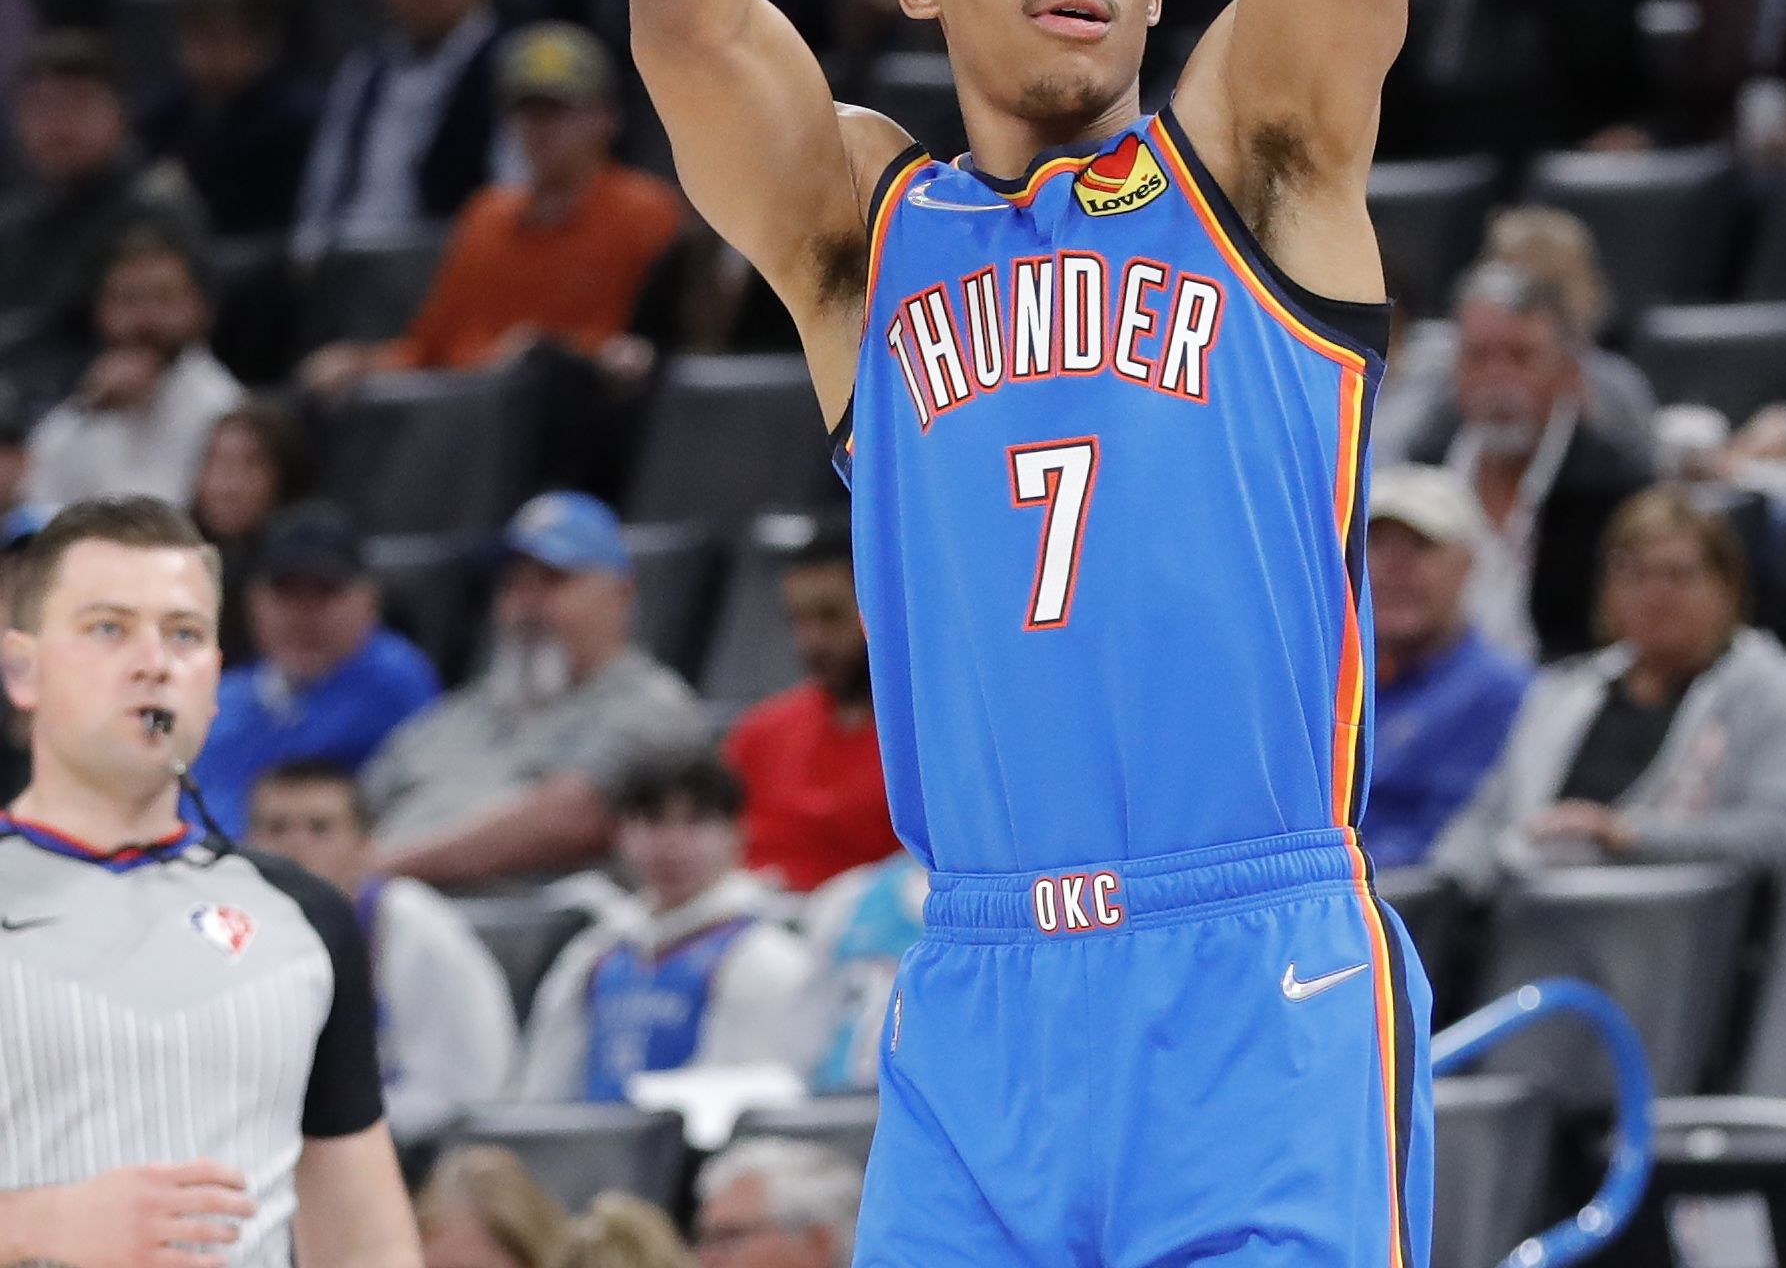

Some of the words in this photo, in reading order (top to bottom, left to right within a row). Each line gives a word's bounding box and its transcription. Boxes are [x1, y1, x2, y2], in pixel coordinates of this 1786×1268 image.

[887, 250, 1225, 435] THUNDER
[1006, 434, 1100, 632] 7
[1031, 870, 1124, 935] OKC
